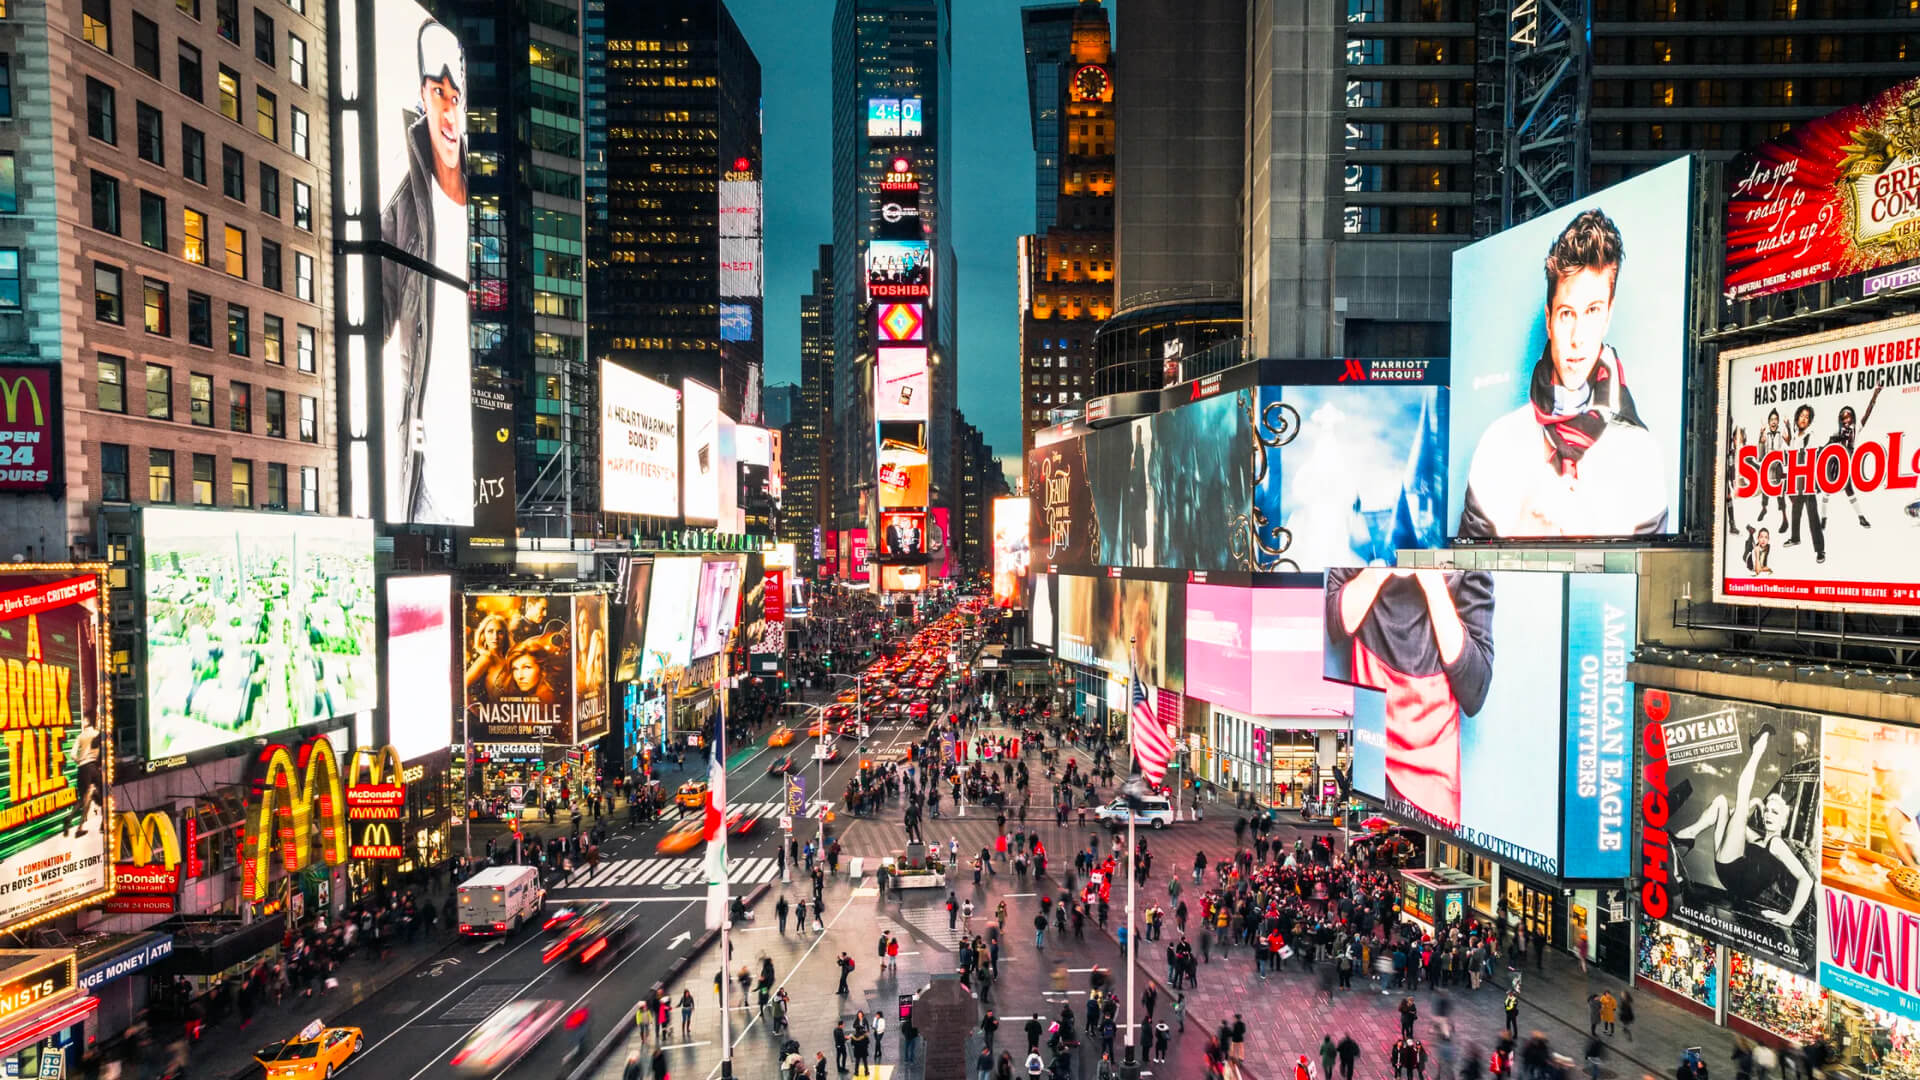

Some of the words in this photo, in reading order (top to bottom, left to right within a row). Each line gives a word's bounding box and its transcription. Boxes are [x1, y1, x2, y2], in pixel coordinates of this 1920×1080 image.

[876, 104, 914, 119] 4:50
[881, 182, 919, 190] TOSHIBA
[887, 173, 913, 182] 2017
[1732, 161, 1770, 197] Are
[1764, 158, 1799, 200] you
[1745, 176, 1794, 232] ready
[1790, 191, 1805, 208] to
[1756, 210, 1796, 253] wake
[1897, 219, 1920, 236] 181
[871, 285, 929, 295] TOSHIBA
[1372, 360, 1429, 368] MARRIOTT
[1817, 348, 1859, 374] LLOYD
[1372, 371, 1422, 379] MARQUIS
[477, 389, 492, 399] BACK
[493, 393, 505, 401] AND
[1754, 384, 1777, 405] HAS
[1781, 372, 1853, 401] BROADWAY
[480, 398, 496, 407] THAN
[615, 405, 675, 438] HEARTWARMING
[0, 431, 40, 442] PEN
[628, 430, 648, 450] BOOK
[0, 445, 34, 465] 24
[1735, 431, 1918, 498] SCHOOL
[1861, 588, 1887, 597] THEATRE
[27, 613, 43, 660] A
[1601, 603, 1626, 756] AMERICAN
[479, 703, 561, 724] NASHVILLE
[533, 725, 553, 735] CMT
[1577, 654, 1599, 799] OUTFITTERS
[1665, 726, 1687, 746] 20
[1686, 714, 1735, 741] YEARS
[484, 744, 544, 753] LUGGAGE
[1672, 750, 1693, 760] KILLING
[1700, 742, 1735, 754] WORLDWIDE
[3, 727, 66, 802] TALE
[348, 791, 402, 799] McDonald's
[1599, 758, 1623, 852] EAGLE
[1641, 688, 1672, 920] CHICAGO
[1384, 800, 1441, 831] AMERICAN
[1440, 817, 1475, 844] EAGLE
[1477, 831, 1558, 876] OUTFITTERS
[23, 854, 64, 875] COMBINATION
[12, 876, 33, 892] BOYS
[41, 866, 61, 882] WEST
[62, 861, 78, 875] SIDE
[116, 873, 175, 884] cDonald's
[1679, 905, 1800, 957] CHICAGOTHEMUSICAL.COM
[106, 952, 145, 978] MONEY
[150, 941, 172, 960] ATM
